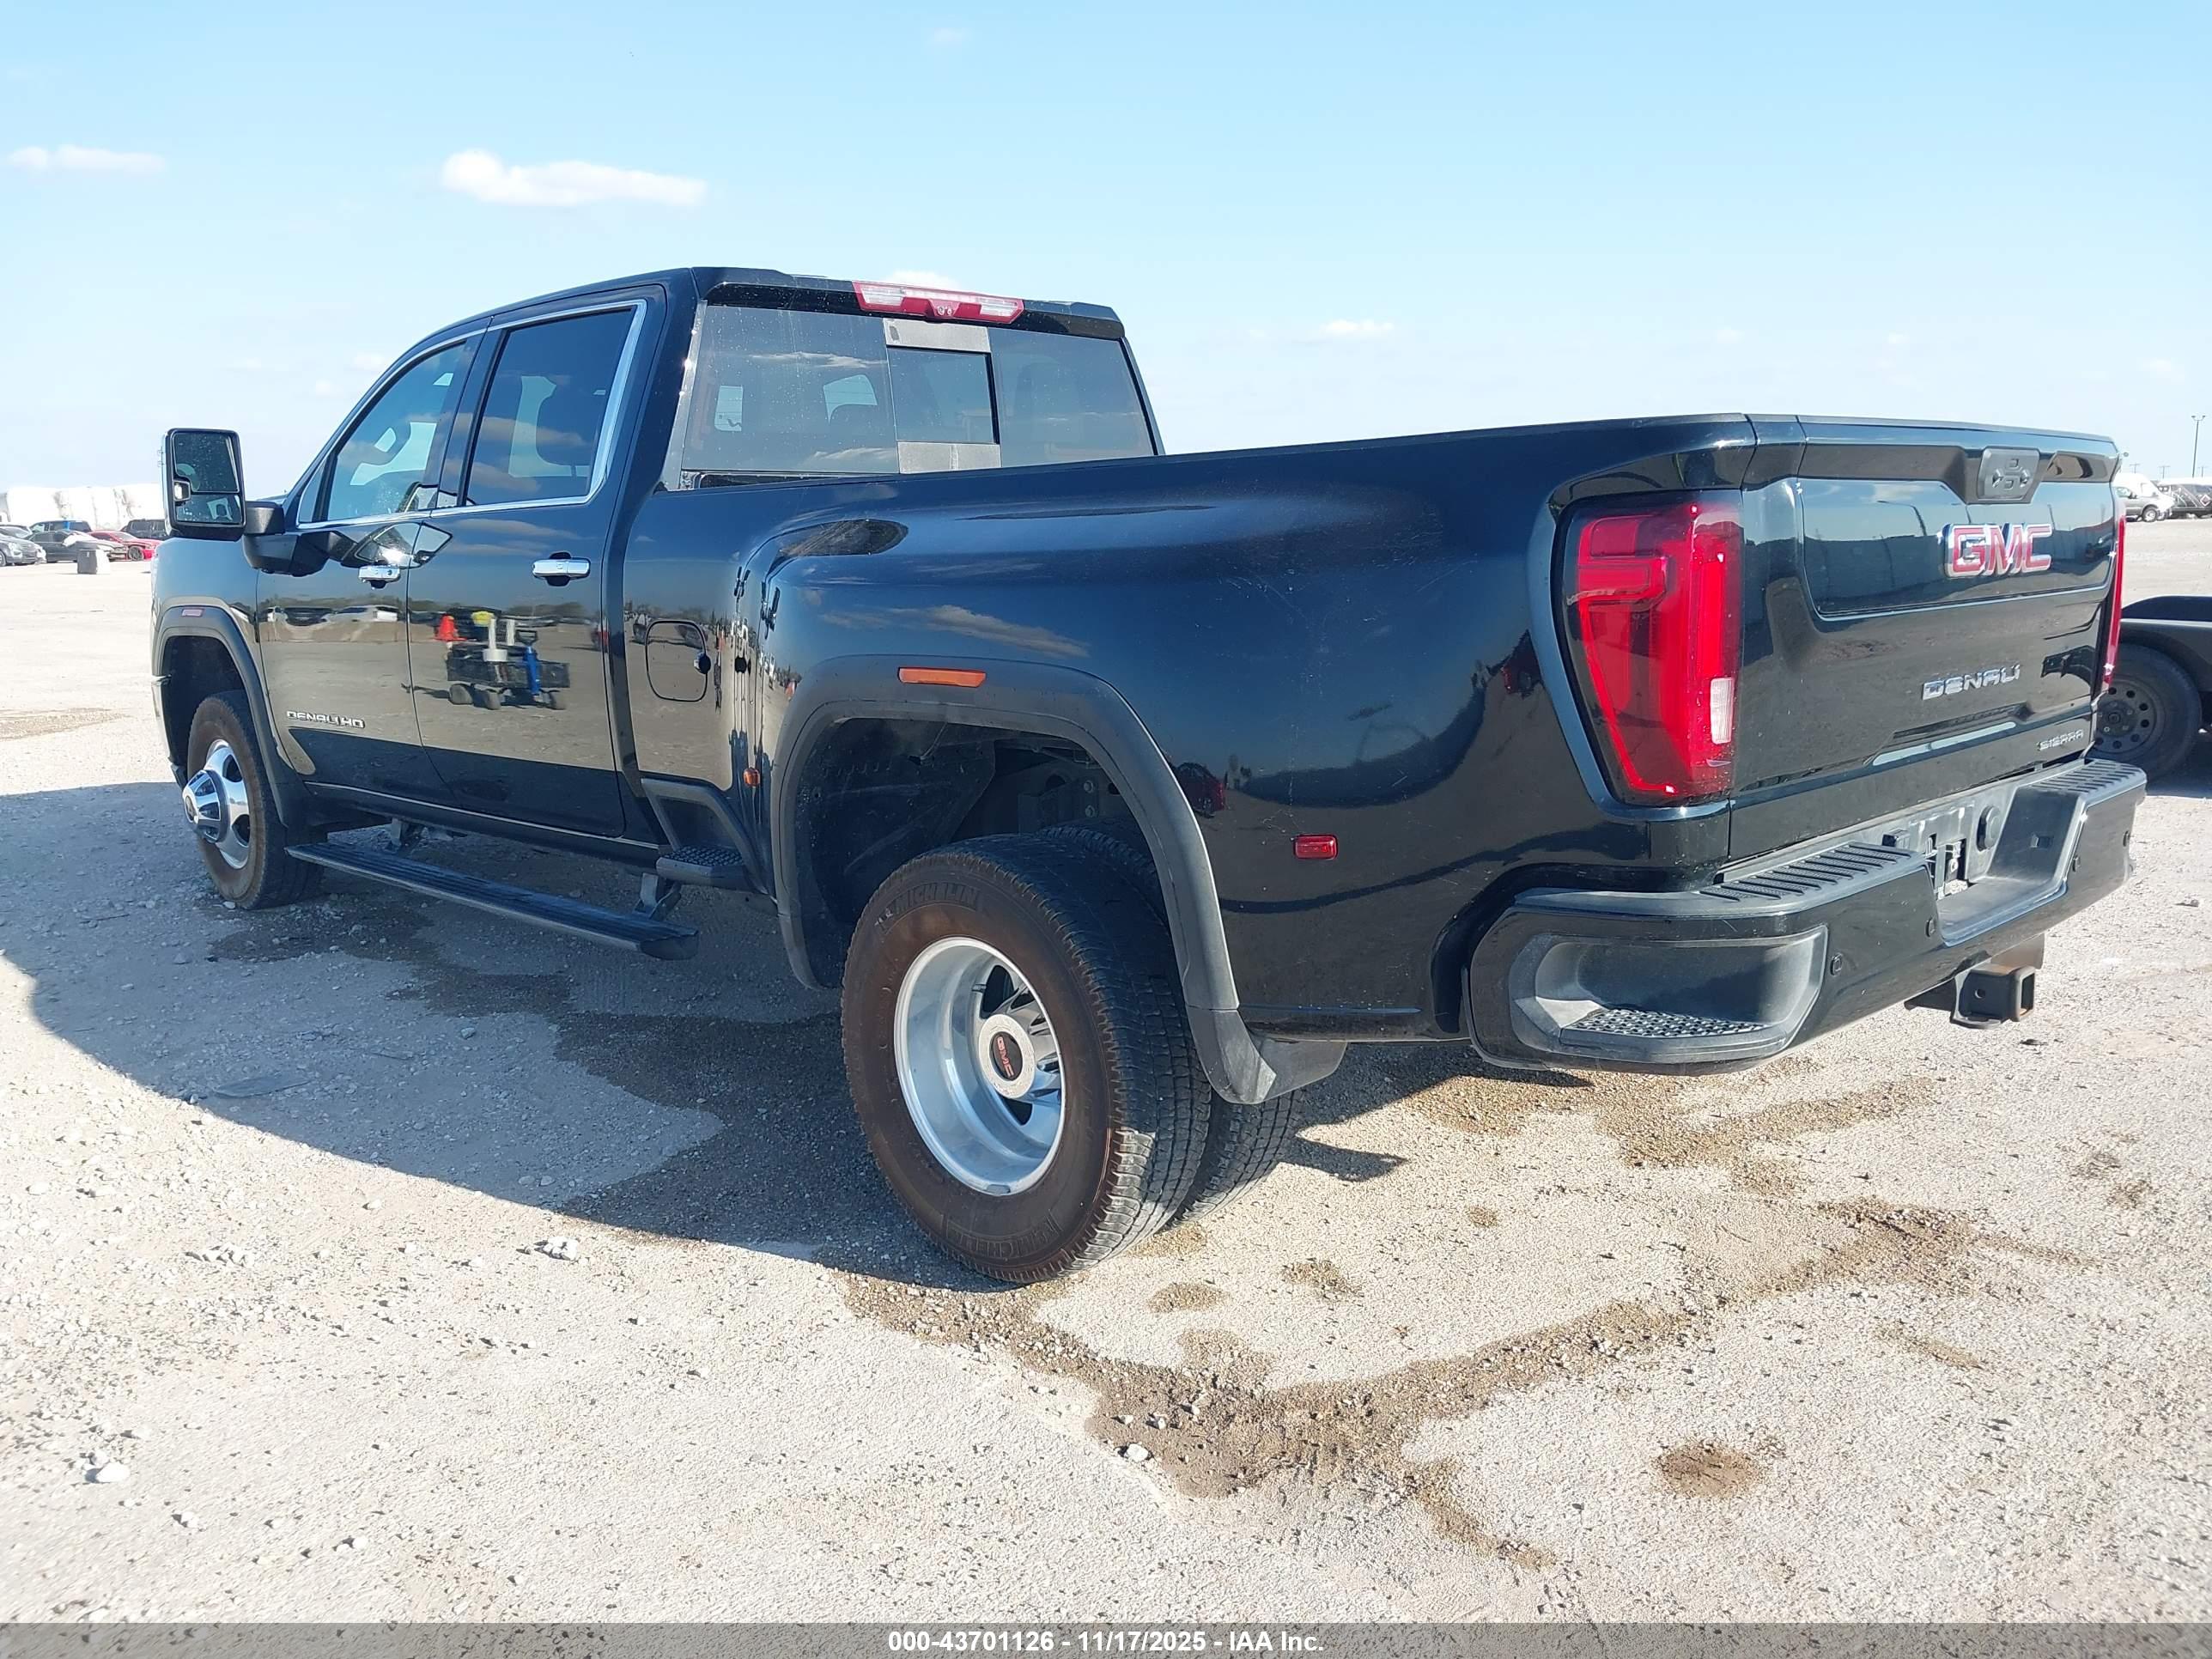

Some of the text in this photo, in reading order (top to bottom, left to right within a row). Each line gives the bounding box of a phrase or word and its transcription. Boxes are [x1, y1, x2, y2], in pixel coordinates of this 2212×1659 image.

[1943, 523, 2052, 578] GMC
[1922, 664, 2021, 700] DENALI
[286, 709, 366, 728] DENALI HD
[2036, 729, 2084, 751] SIERRA
[997, 1036, 1015, 1078] GMC
